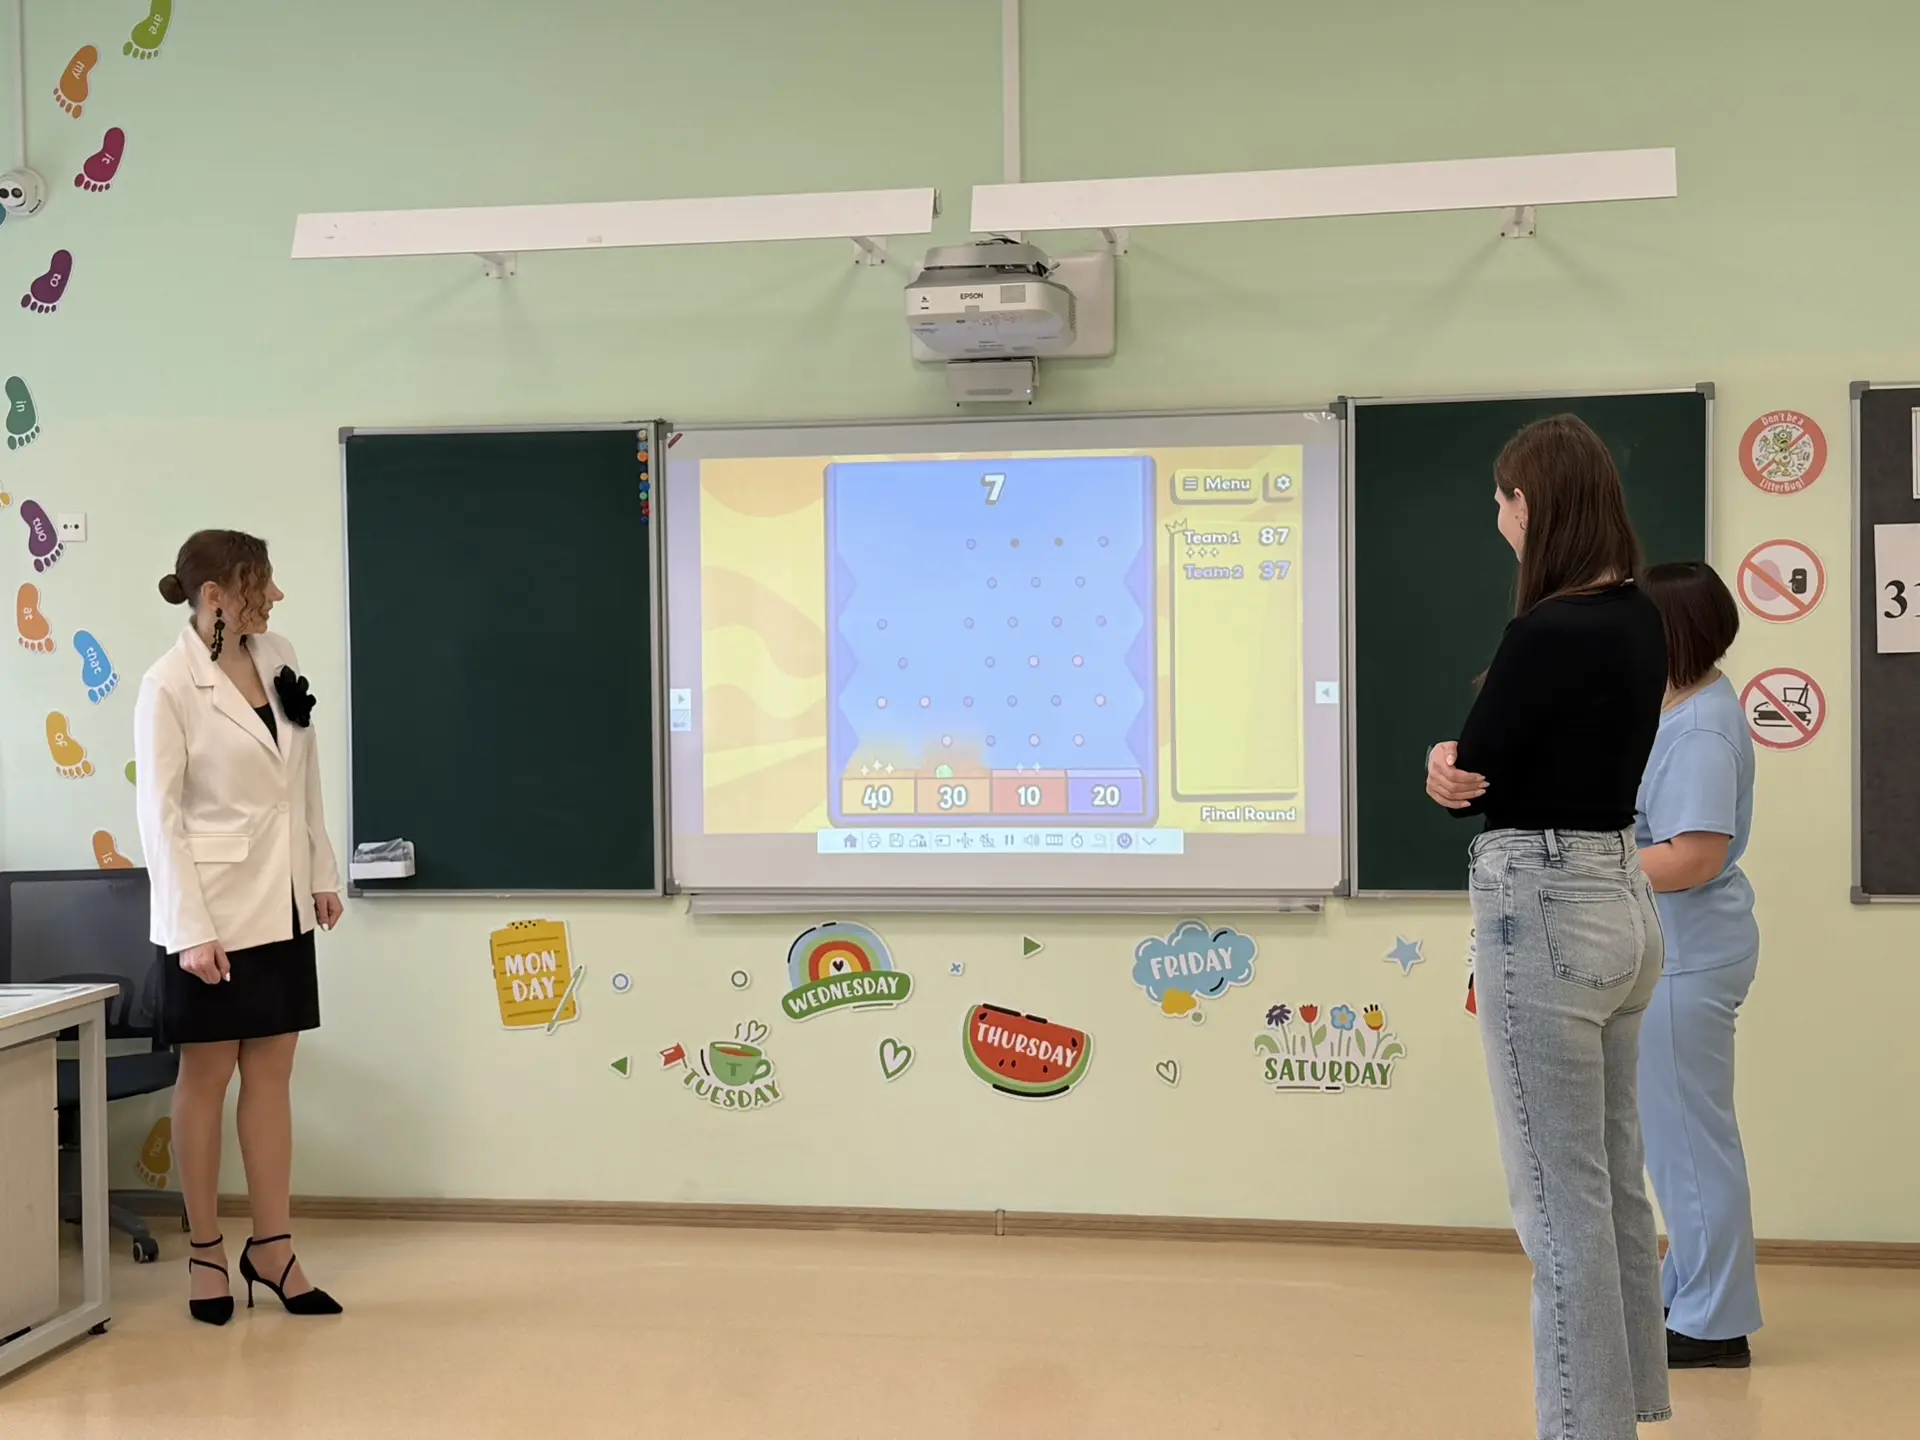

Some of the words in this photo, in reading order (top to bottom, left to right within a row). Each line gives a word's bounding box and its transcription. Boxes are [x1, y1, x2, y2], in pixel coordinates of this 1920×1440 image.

[149, 13, 163, 35] are
[72, 60, 86, 80] my
[50, 272, 63, 288] to
[960, 292, 984, 301] EPSON
[15, 400, 28, 413] in
[1760, 412, 1785, 426] Don't
[1786, 412, 1798, 423] be
[983, 473, 1007, 504] 7
[1203, 476, 1252, 492] Menu
[33, 517, 47, 542] two
[1183, 529, 1230, 545] Team
[1230, 530, 1241, 545] 1
[1259, 526, 1291, 546] 87
[1183, 563, 1230, 580] Team
[1231, 564, 1244, 580] 2
[1259, 560, 1292, 581] 37
[23, 607, 34, 621] at
[86, 646, 103, 675] that
[55, 732, 68, 747] of
[862, 784, 894, 810] 40
[938, 784, 968, 810] 30
[1015, 784, 1041, 808] 10
[1091, 783, 1121, 808] 20
[1200, 806, 1241, 822] Final
[1243, 806, 1298, 822] Round
[505, 950, 556, 977] MON
[1150, 947, 1232, 980] FRIDAY
[511, 977, 557, 1004] DAY
[788, 976, 900, 1014] WEDNESDAY
[976, 1021, 1078, 1069] THURSDAY
[725, 1060, 743, 1077] T
[1264, 1057, 1392, 1086] SATURDAY
[683, 1067, 781, 1109] TUESDAY
